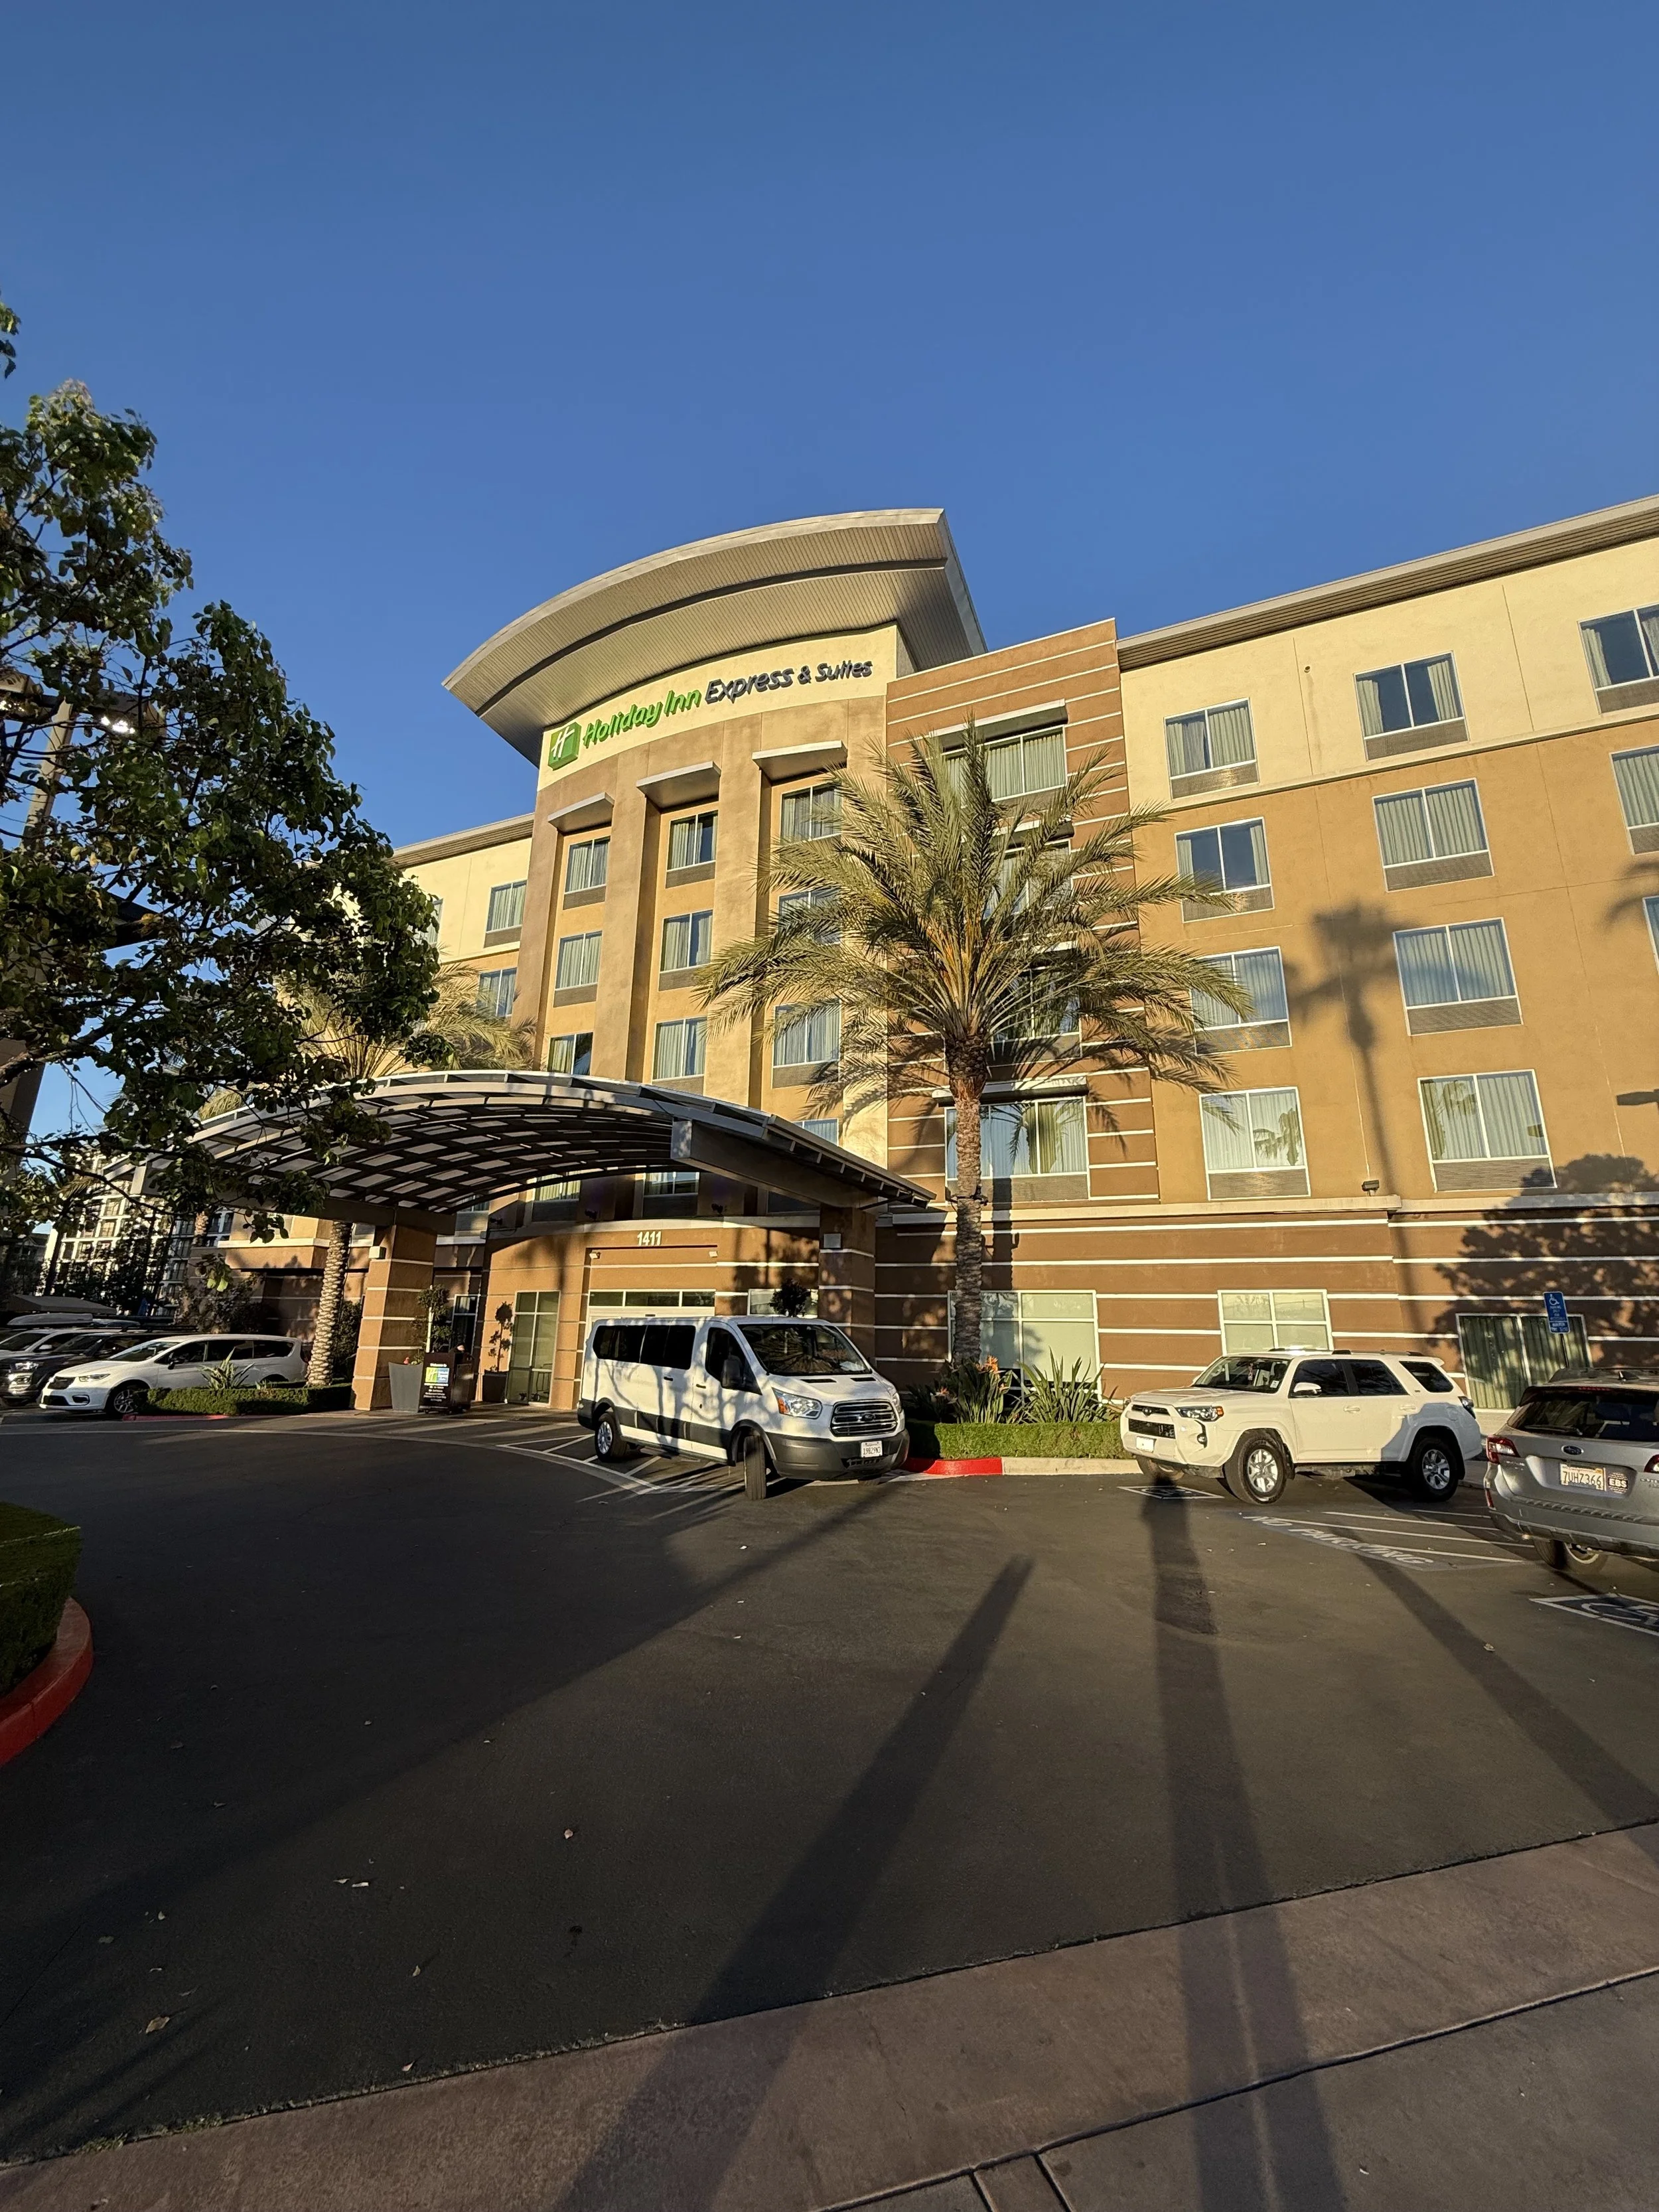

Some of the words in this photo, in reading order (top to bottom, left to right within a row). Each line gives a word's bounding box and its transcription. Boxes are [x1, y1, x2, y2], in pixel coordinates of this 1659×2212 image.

[583, 701, 663, 749] Holiday
[664, 690, 701, 717] Inn
[705, 668, 794, 703] Express
[797, 665, 812, 684] &
[815, 660, 873, 682] Suites
[637, 1231, 662, 1246] 1411
[1562, 1470, 1603, 1489] 7UHZ366
[1609, 1478, 1627, 1488] EBS
[1243, 1516, 1293, 1526] NO
[1288, 1528, 1433, 1564] PARKING
